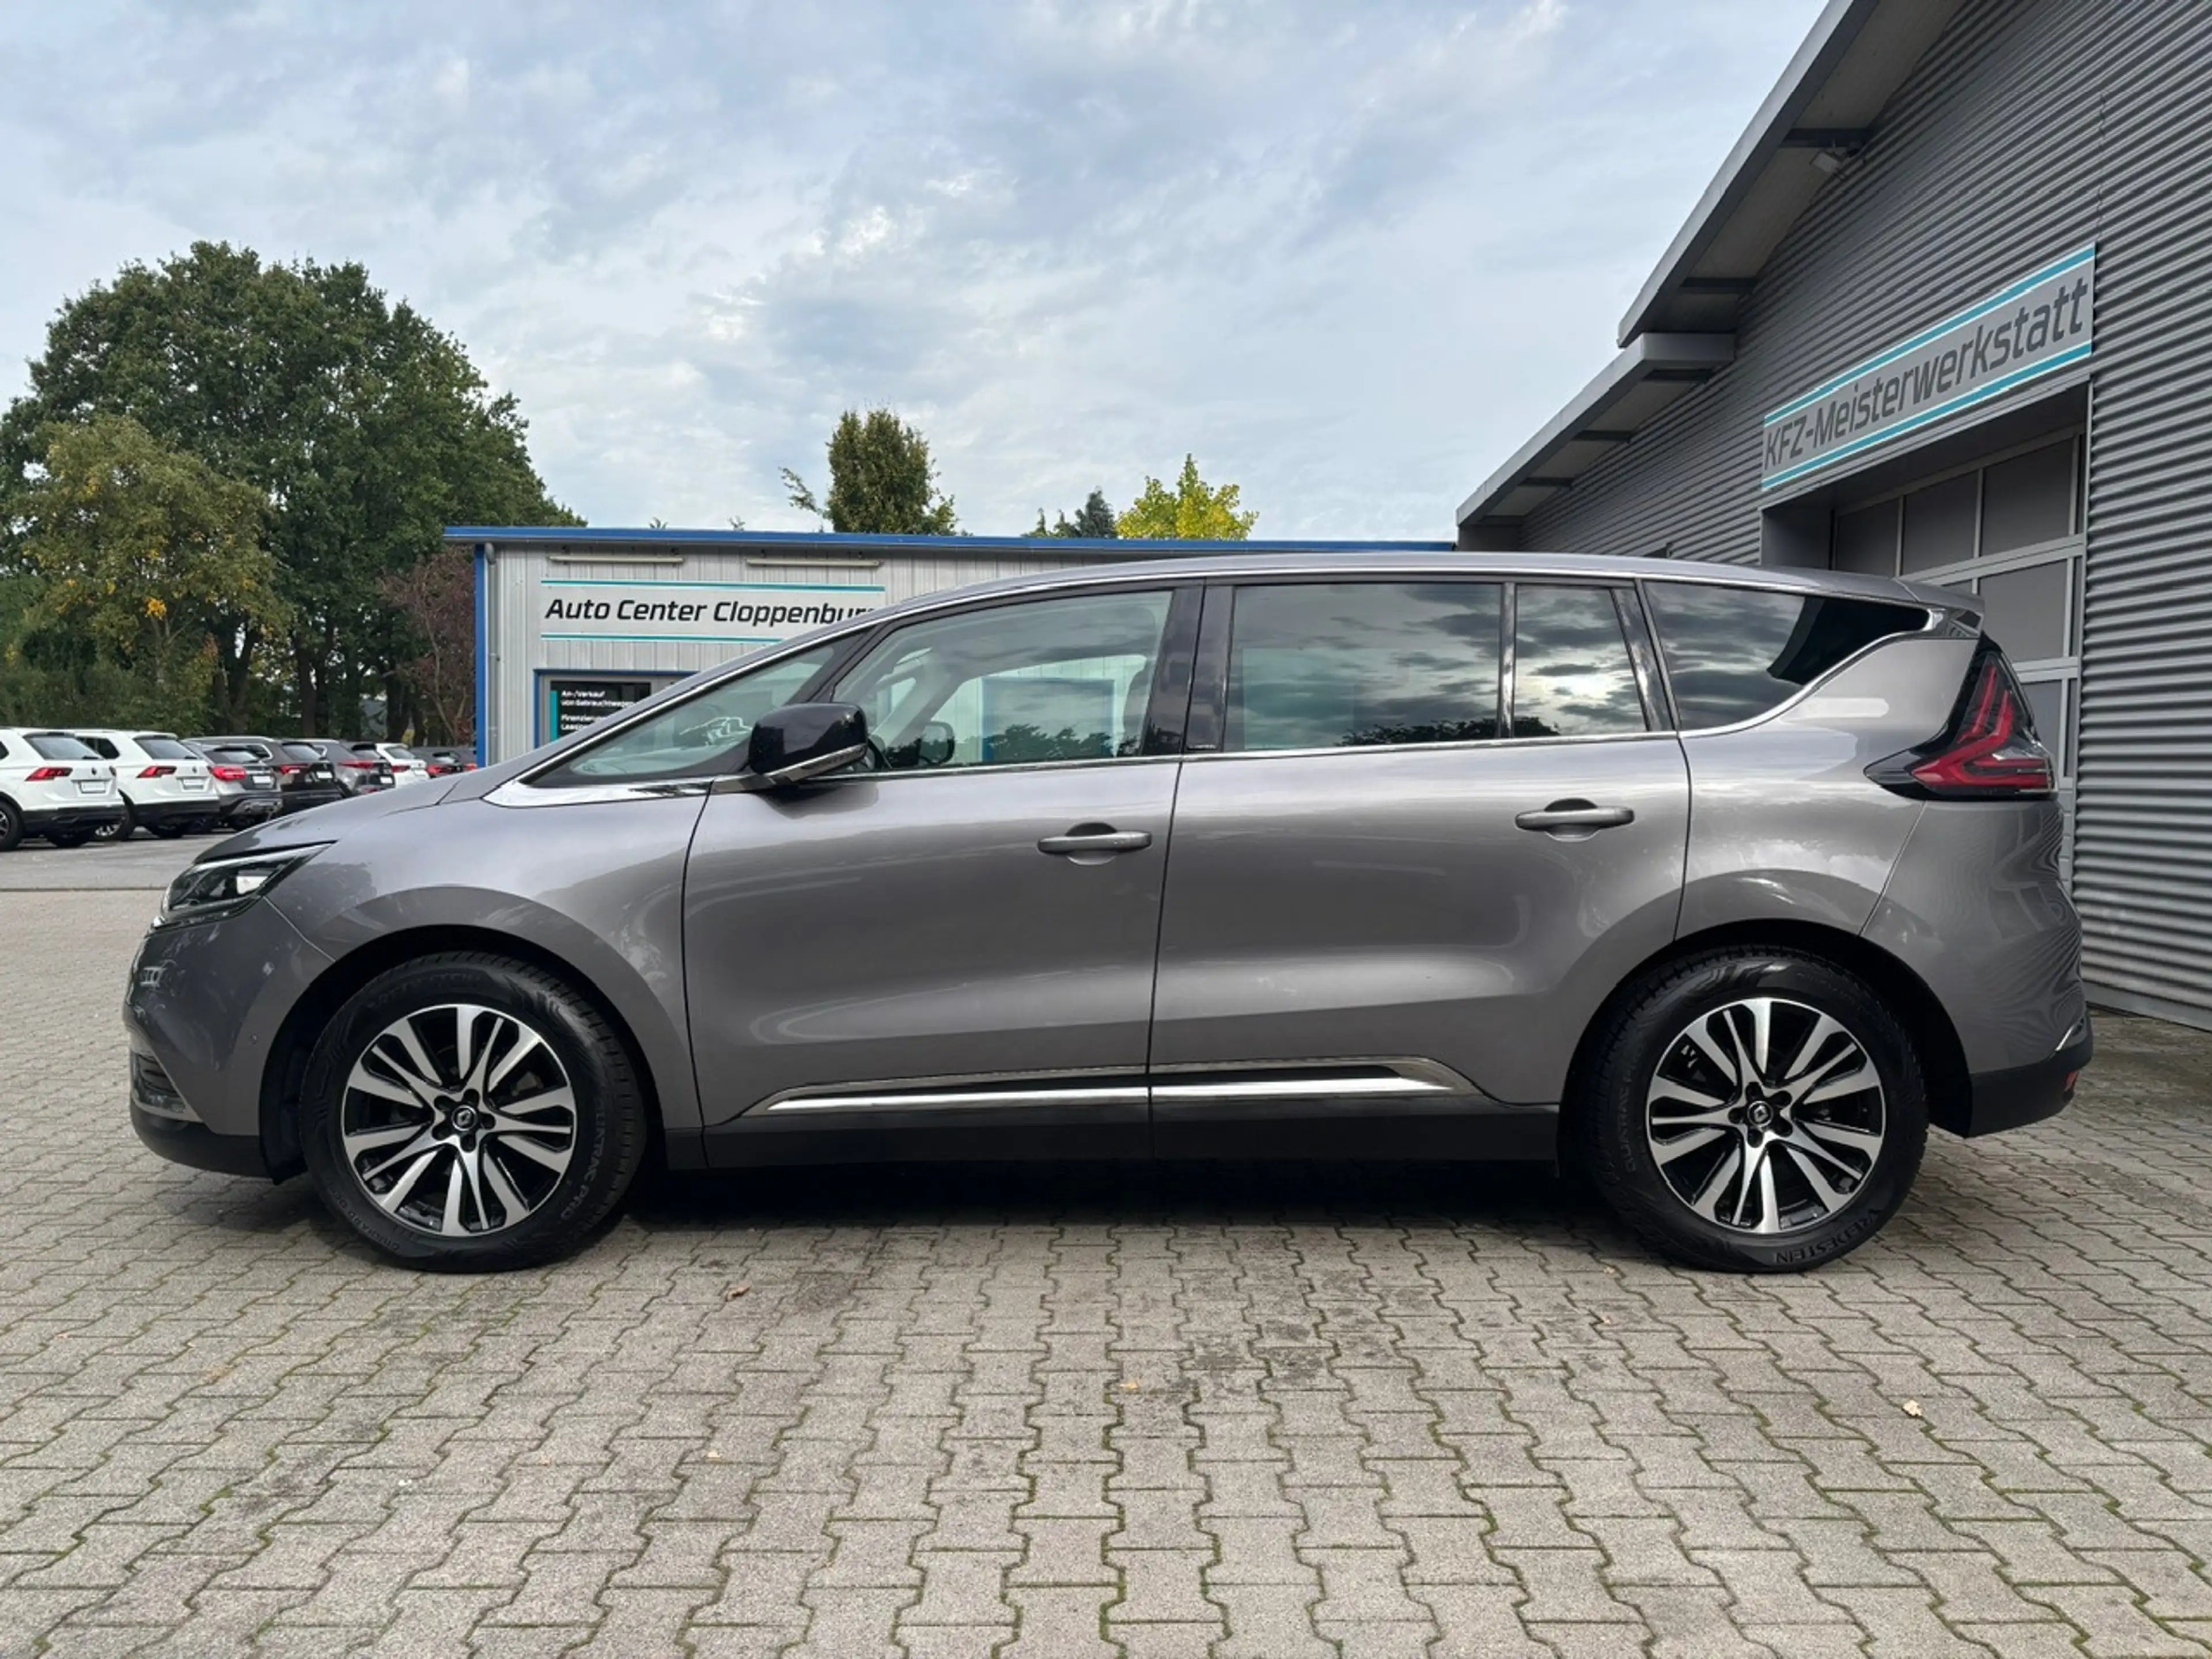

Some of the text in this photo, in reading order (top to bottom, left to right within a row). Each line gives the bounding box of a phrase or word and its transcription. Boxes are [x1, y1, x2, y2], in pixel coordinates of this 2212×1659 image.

[1764, 277, 2088, 470] KFZ-Meisterwerkstatt
[544, 599, 874, 627] Auto Center Cloppenbur
